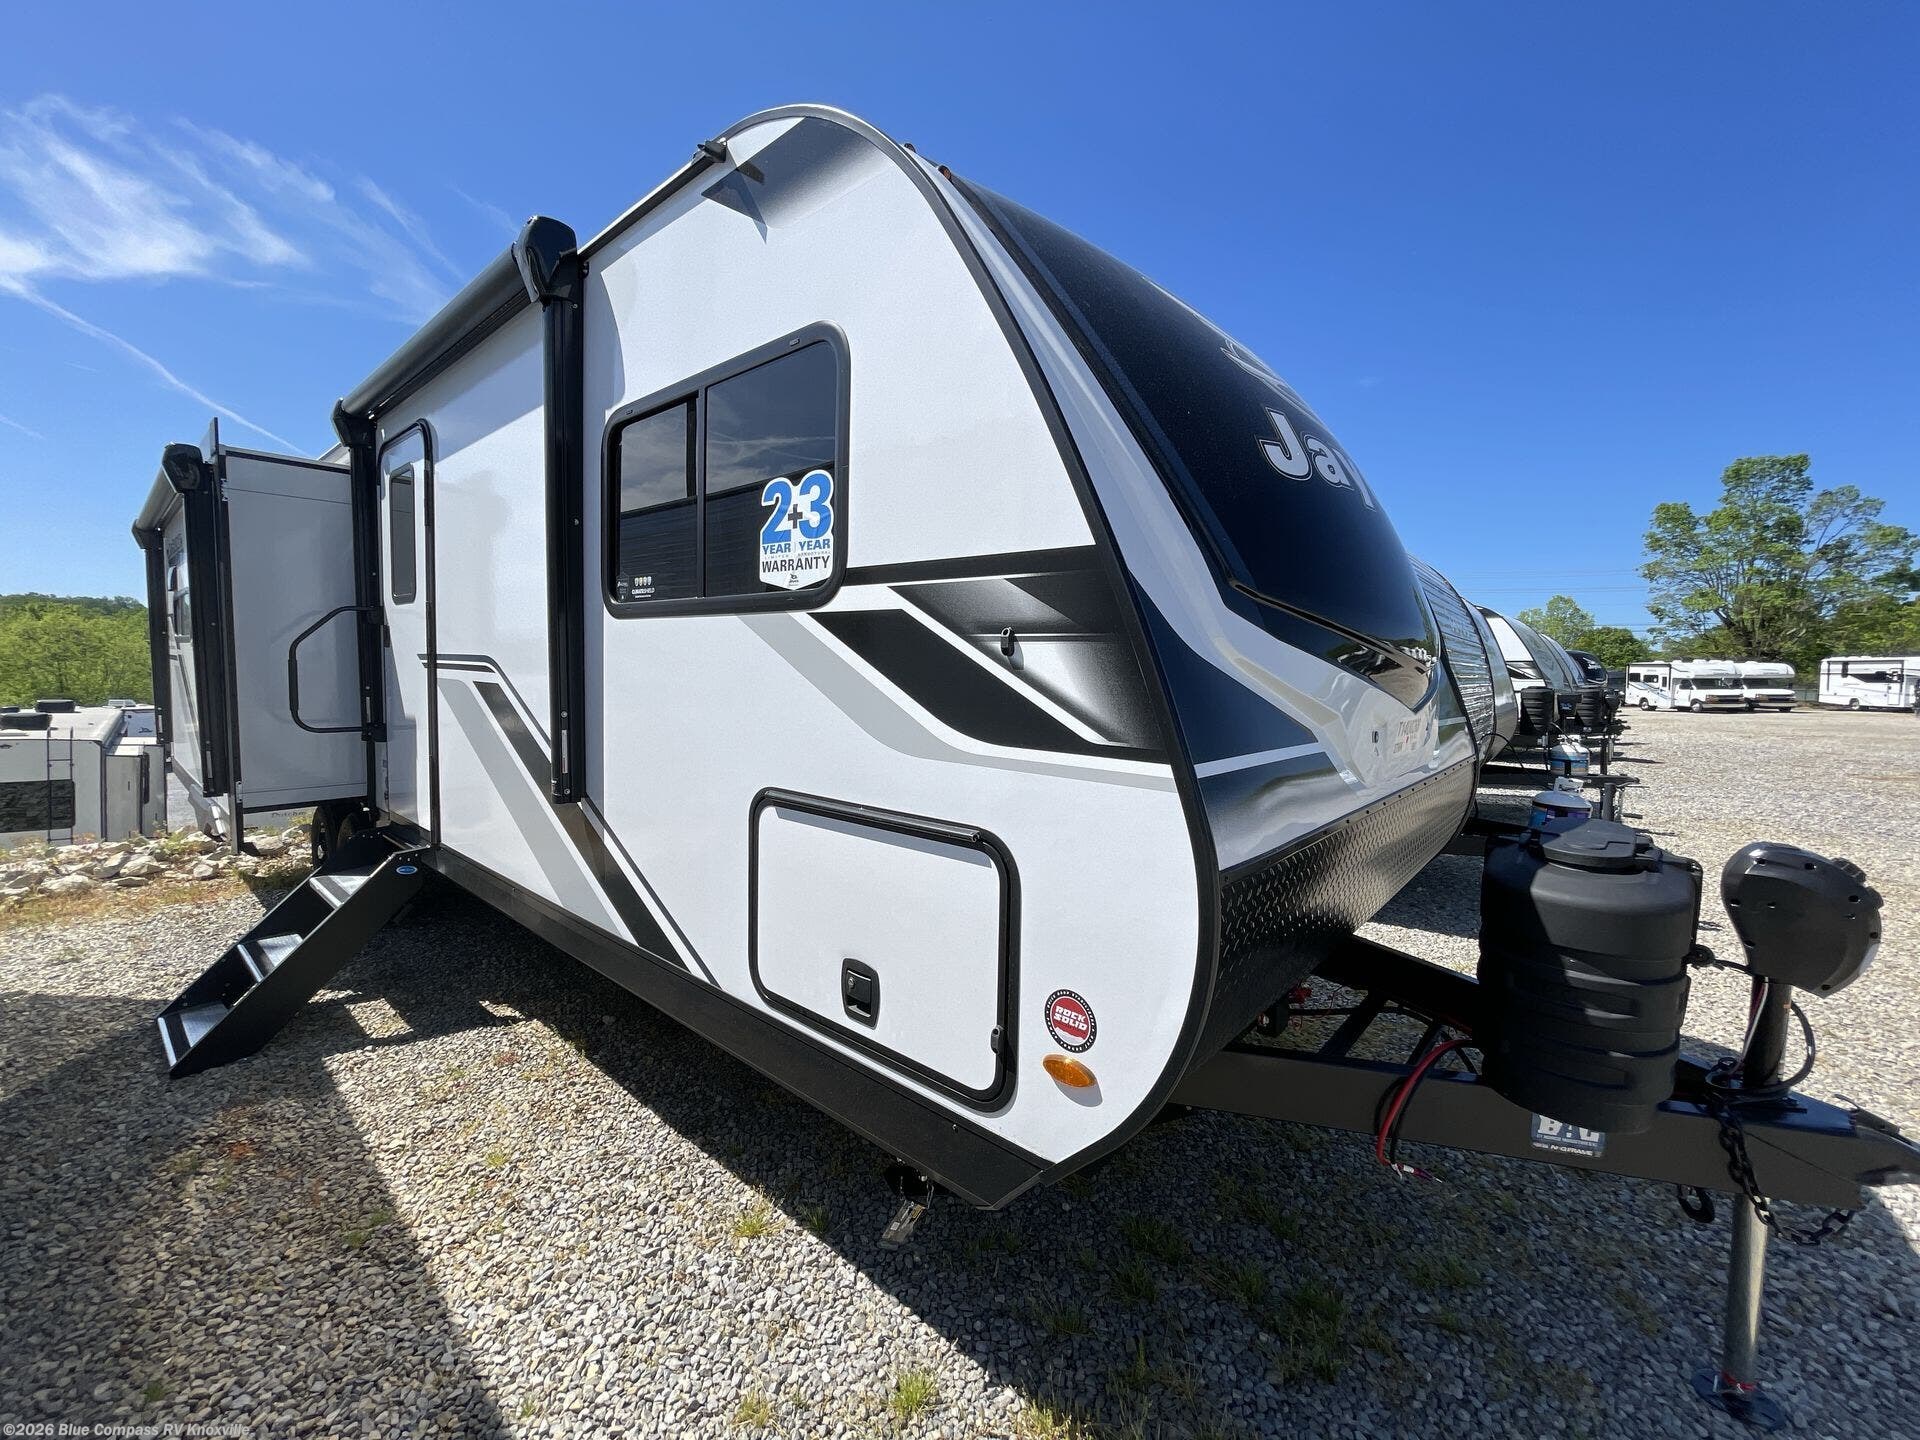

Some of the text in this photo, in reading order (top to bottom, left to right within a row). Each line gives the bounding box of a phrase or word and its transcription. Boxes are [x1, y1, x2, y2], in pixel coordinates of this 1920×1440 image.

[762, 538, 831, 555] YEAR YEAR
[761, 555, 830, 573] WARRANTY
[1053, 1012, 1088, 1031] SOLID
[1055, 1005, 1087, 1023] ROCK
